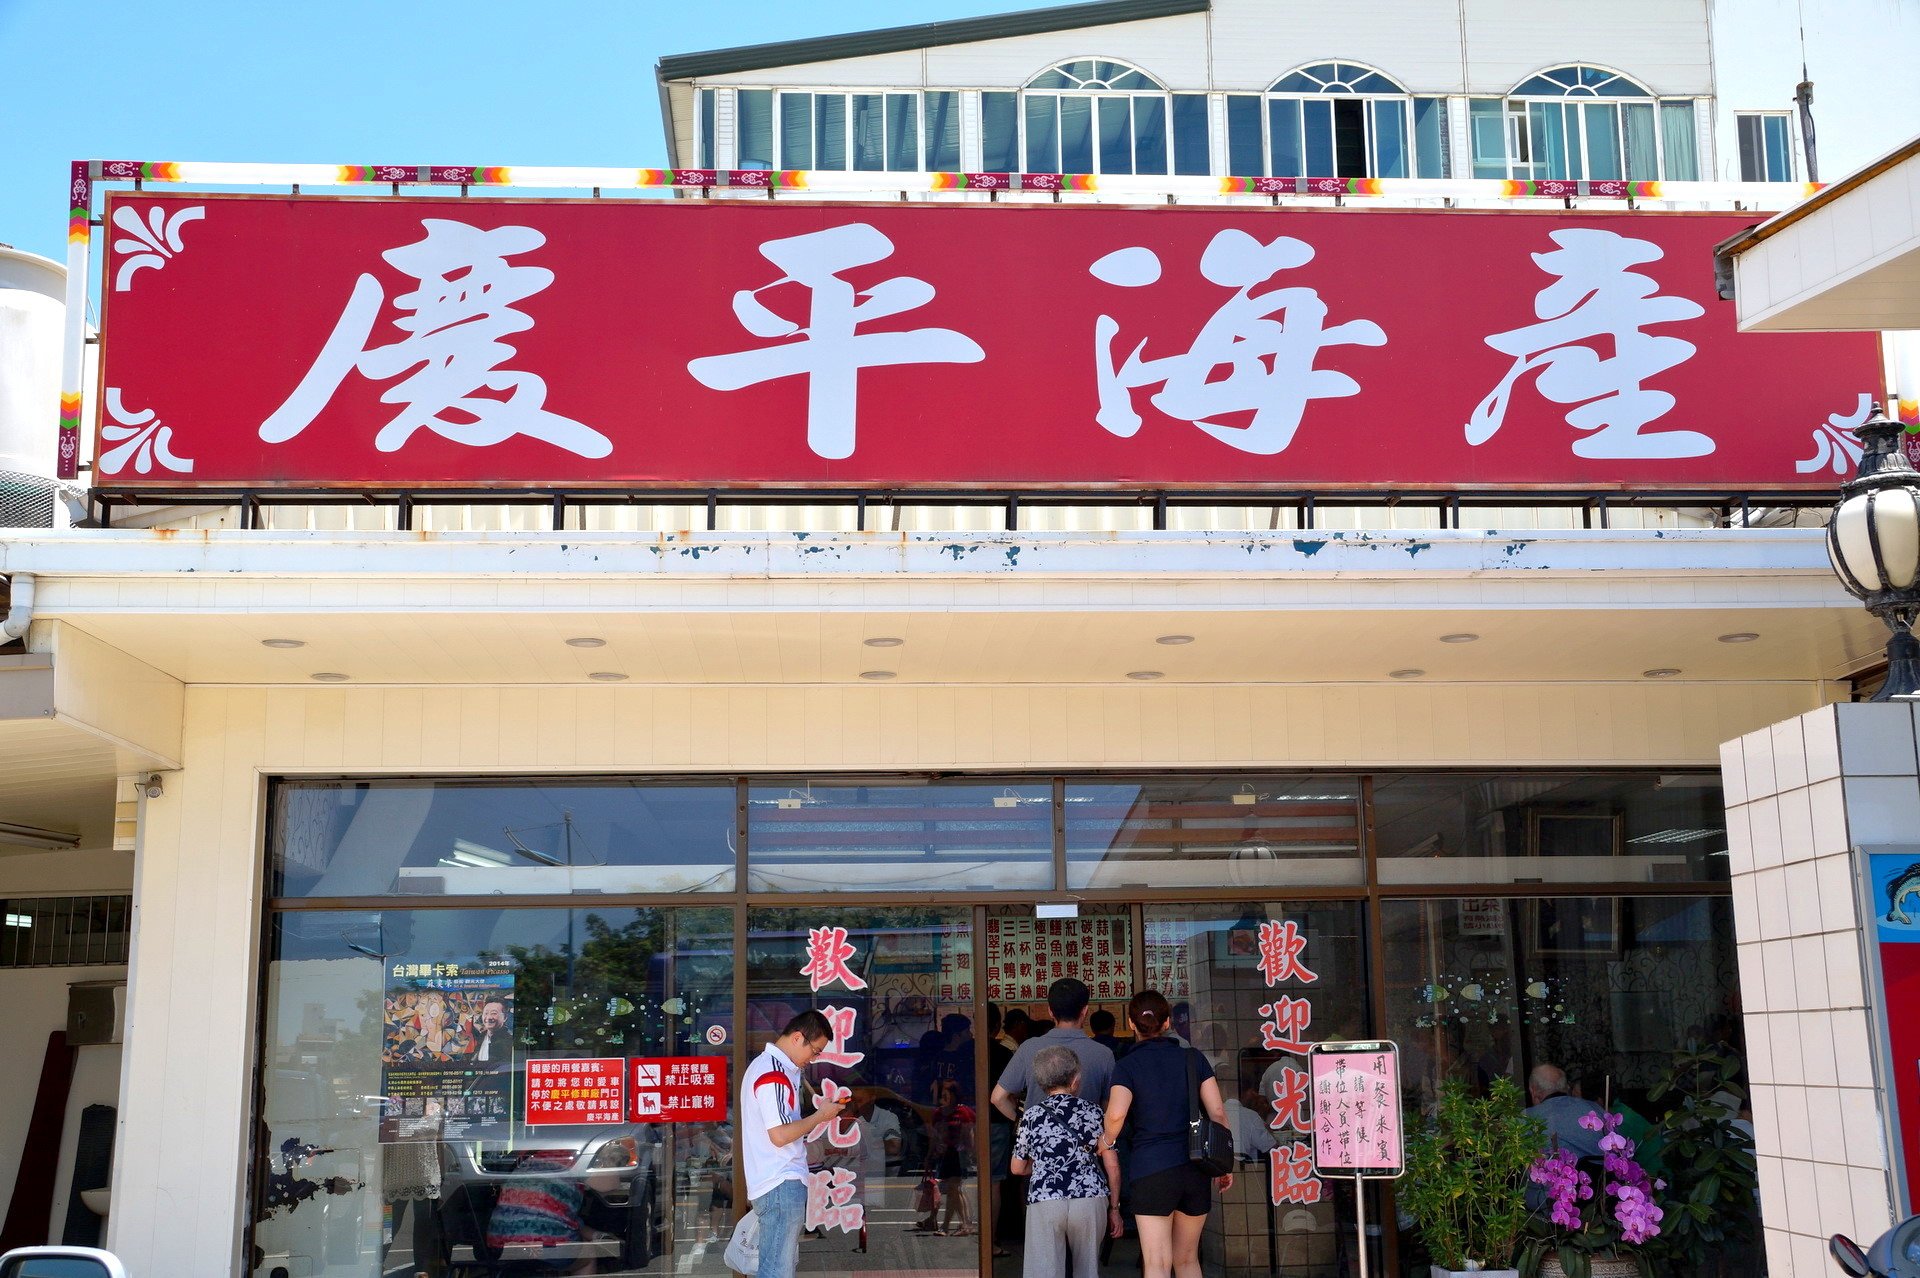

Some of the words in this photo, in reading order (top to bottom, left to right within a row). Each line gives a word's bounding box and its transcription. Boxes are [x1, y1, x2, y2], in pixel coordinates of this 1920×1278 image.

[259, 218, 1716, 459] 慶平海產
[393, 964, 459, 977] 台灣畢卡索
[1003, 920, 1017, 1000] 三杯鴨舌
[1019, 920, 1032, 999] 三杯軟絲
[1049, 919, 1063, 980] 鱔魚意
[1065, 920, 1079, 978] 紅燒鮮
[1096, 919, 1111, 998] 蒜頭蒸魚
[664, 1074, 715, 1086] 禁止吸煙
[800, 926, 868, 1233] 歡迎光臨
[1257, 920, 1321, 1206] 歡迎光臨
[586, 1112, 619, 1122] 慶平海產
[667, 1095, 715, 1109] 禁止寵物
[1319, 1080, 1334, 1155] 謝謝合作
[1335, 1058, 1352, 1167] 帶位人員帶位
[1354, 1076, 1370, 1144] 請等候
